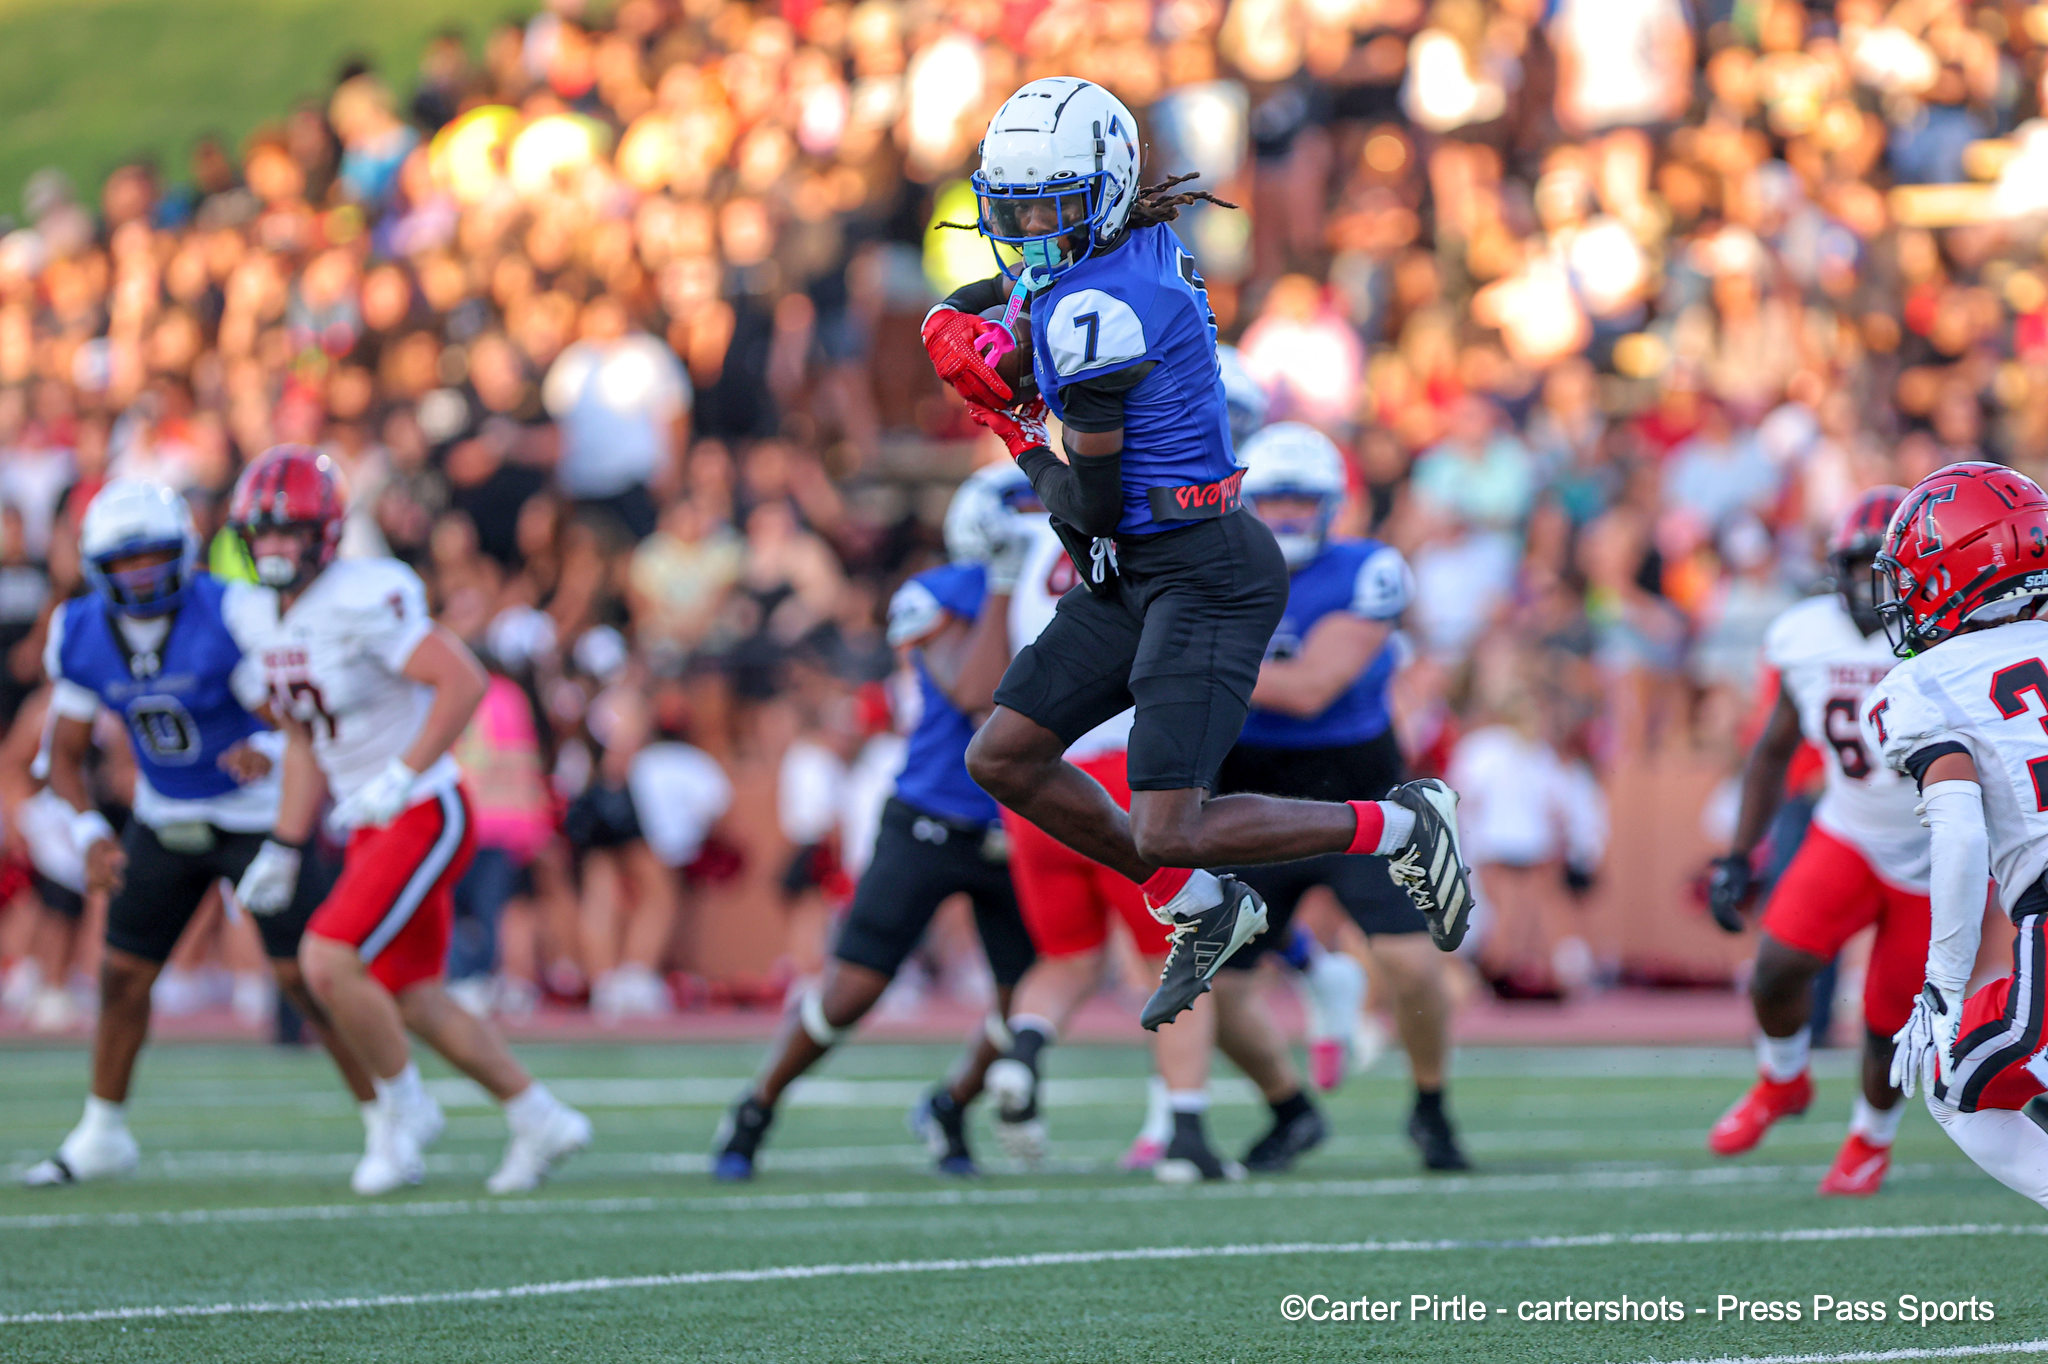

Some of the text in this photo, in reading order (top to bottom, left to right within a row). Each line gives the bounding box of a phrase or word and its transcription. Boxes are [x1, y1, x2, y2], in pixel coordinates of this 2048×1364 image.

[1108, 114, 1135, 162] 7
[1073, 310, 1101, 363] 7
[1899, 483, 1958, 559] T
[2024, 570, 2048, 588] sch
[1826, 697, 1872, 780] 6
[1868, 697, 1891, 748] T
